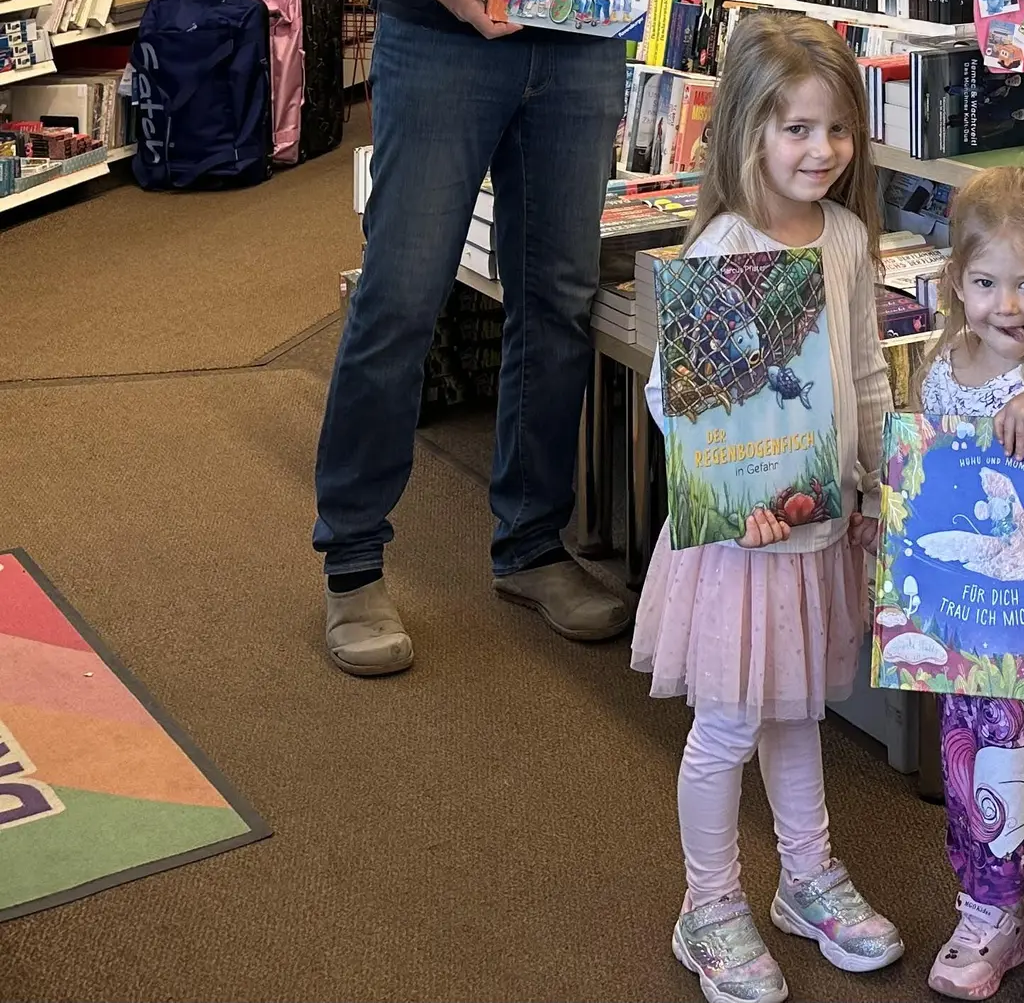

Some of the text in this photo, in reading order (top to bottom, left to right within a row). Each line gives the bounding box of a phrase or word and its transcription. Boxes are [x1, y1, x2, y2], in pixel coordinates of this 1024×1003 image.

[970, 59, 978, 89] Nemec
[139, 42, 165, 164] Satch
[970, 100, 978, 146] Wachtveitl
[694, 430, 816, 469] REGENBOGENFISCH
[705, 428, 727, 445] DER
[735, 461, 779, 476] in Gefahr
[962, 584, 1020, 606] FÜR DICH
[939, 597, 971, 623] TRAU
[976, 607, 997, 626] ICH
